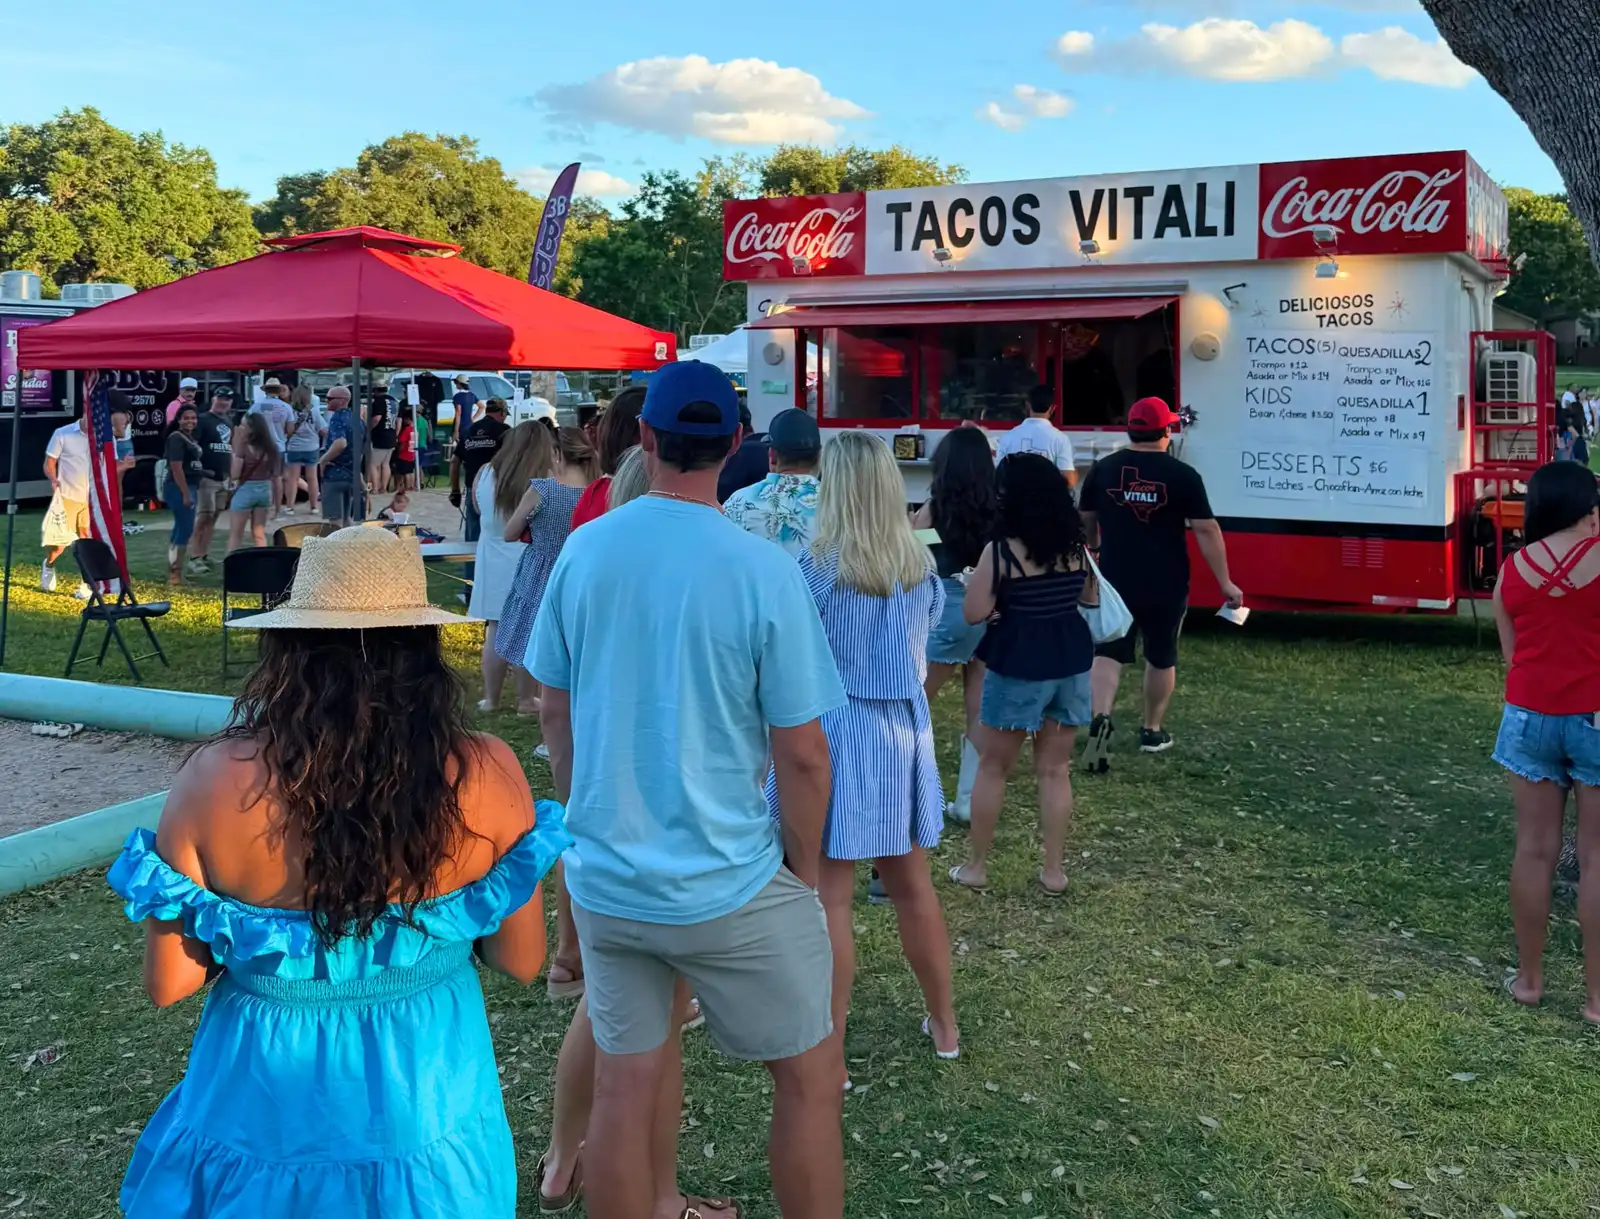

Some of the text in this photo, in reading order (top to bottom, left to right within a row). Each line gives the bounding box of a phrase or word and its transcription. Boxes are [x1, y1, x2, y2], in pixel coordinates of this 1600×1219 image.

[1261, 168, 1463, 239] Coca-Cola
[886, 181, 1236, 252] TACOS VITALI
[726, 204, 864, 264] Coca-Cola
[1279, 294, 1374, 313] DELICIOSOS
[1316, 311, 1374, 328] TACOS
[1246, 337, 1316, 355] TACOS
[1338, 340, 1432, 366] QUESADILLAS 2
[1251, 360, 1309, 371] Trompo $12
[1346, 363, 1382, 379] Trompo
[4, 374, 48, 390] Sndae
[1246, 371, 1275, 380] Asada
[1291, 371, 1309, 381] Mix
[1311, 371, 1330, 381] $14
[1343, 375, 1373, 385] Asada
[1395, 375, 1415, 387] Mix
[1245, 385, 1293, 405] KIDS
[1337, 391, 1431, 416] QUESADILLA 1
[1342, 413, 1396, 426] Trompo $8
[1340, 426, 1370, 437] Asada
[1390, 428, 1410, 440] Mix
[1412, 430, 1426, 442] $9
[1369, 460, 1388, 474] $6
[1243, 475, 1266, 489] Tres
[1123, 491, 1158, 502] VITALI
